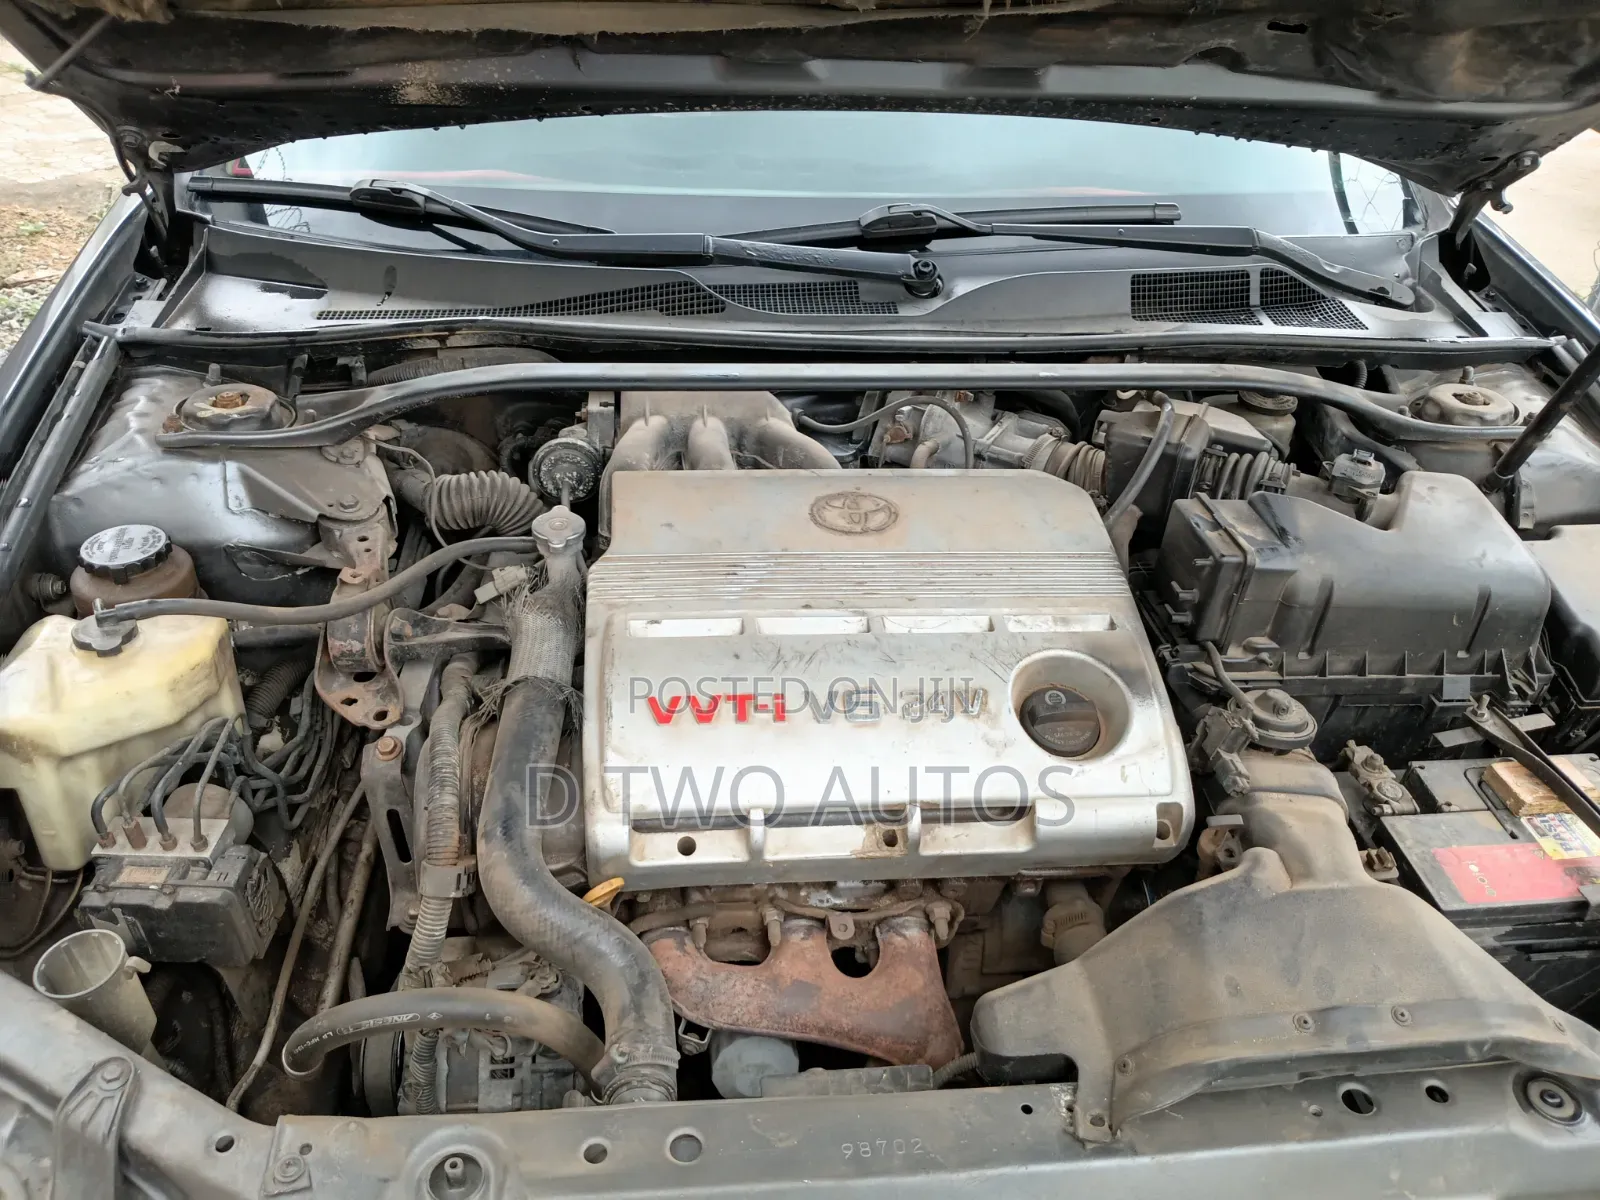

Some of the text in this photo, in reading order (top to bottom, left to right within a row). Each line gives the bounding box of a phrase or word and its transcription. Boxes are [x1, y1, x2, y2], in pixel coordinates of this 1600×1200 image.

[646, 686, 983, 726] VVT-i V6 24V
[841, 1138, 924, 1159] 98702
